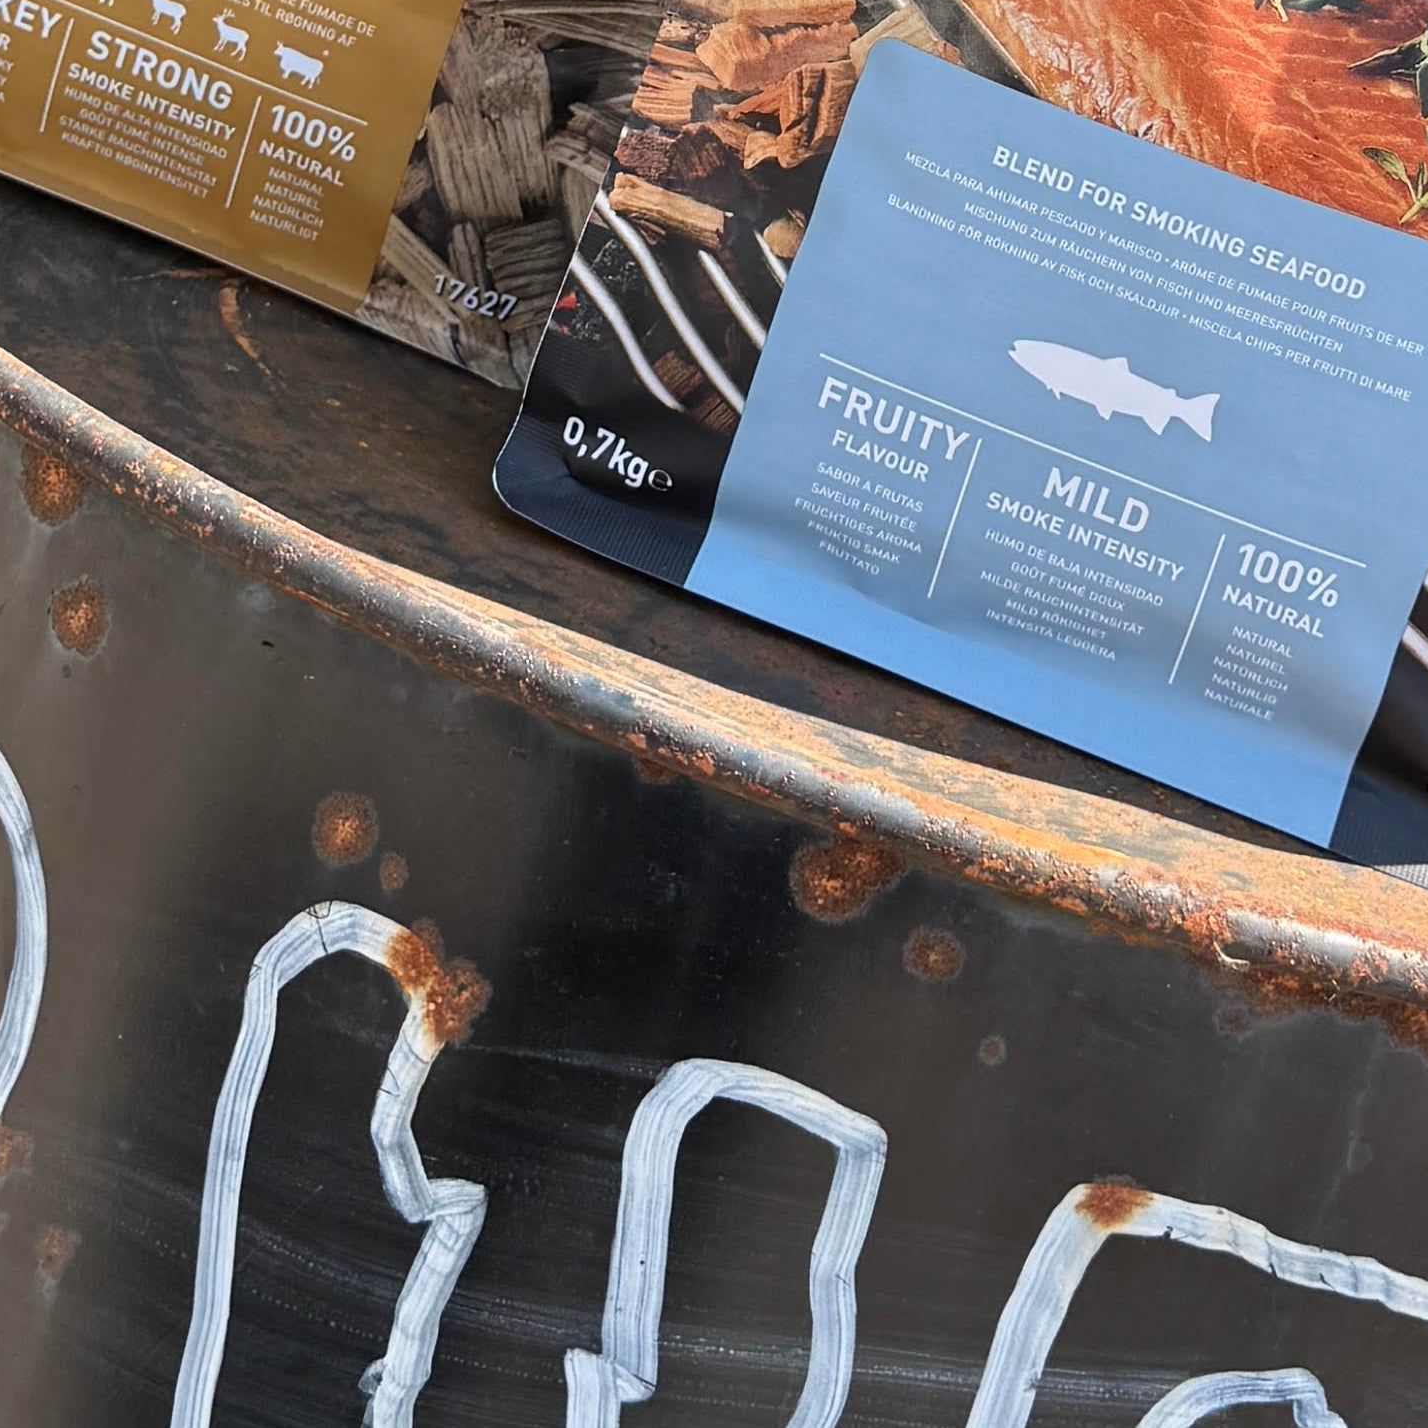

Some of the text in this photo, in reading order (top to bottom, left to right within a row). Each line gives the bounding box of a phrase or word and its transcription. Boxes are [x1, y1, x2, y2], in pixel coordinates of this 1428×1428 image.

[68, 61, 236, 140] SMOKE INTENSITY
[86, 30, 233, 112] STRONG
[269, 103, 357, 163] 100%
[258, 140, 344, 187] NATURAL
[904, 152, 1424, 355] MEZCLA PARA AHUMAR PESCADO Y MARISCO ARÔME DE FUMAGE POUR FRUITS DE MER
[992, 146, 1367, 300] BLEND FOR SMOKING SEAFOOD
[434, 274, 518, 321] 17627
[963, 201, 1343, 352] MISCHUNG ZUM RÄUCHERN VON FISCH UND MEERESFRÜCHTEN
[818, 376, 1340, 611] FRUITY MILD 100%
[831, 430, 930, 483] FLAVOUR
[986, 490, 1186, 583] SMOKE INTENSITY
[1222, 584, 1325, 640] NATURAL
[1232, 625, 1293, 658] NATURAL
[1226, 643, 1285, 675] NATUREL
